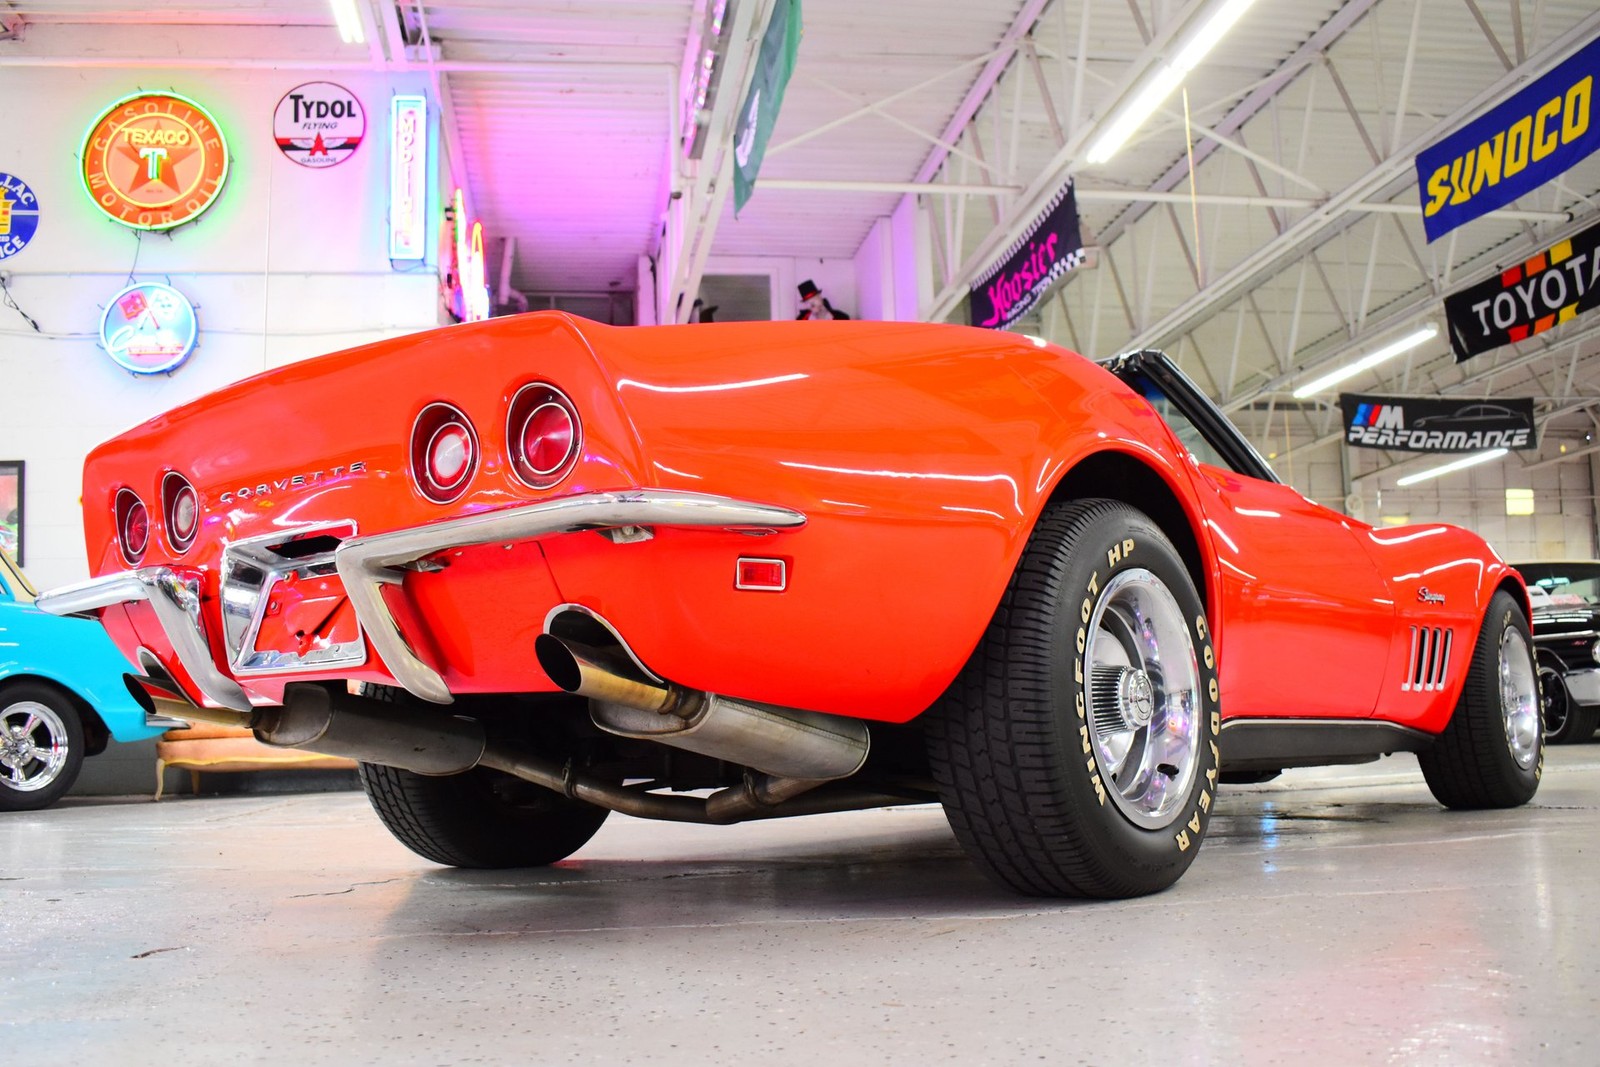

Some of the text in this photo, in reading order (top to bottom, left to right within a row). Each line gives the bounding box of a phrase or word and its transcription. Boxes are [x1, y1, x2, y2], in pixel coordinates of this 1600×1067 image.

[94, 102, 220, 151] GASOLINE
[290, 95, 356, 123] TYDOL
[302, 122, 338, 130] FLYING
[121, 127, 190, 146] TEXACO
[1424, 75, 1593, 217] SUNOCO
[300, 156, 337, 164] GASOLINE
[89, 172, 223, 226] MOTOR OIL
[1349, 426, 1530, 450] PERFORMANCE
[220, 461, 367, 504] CORVETTE
[1075, 538, 1135, 806] WINGFOOT HP
[1174, 615, 1220, 852] GOODYEAR
